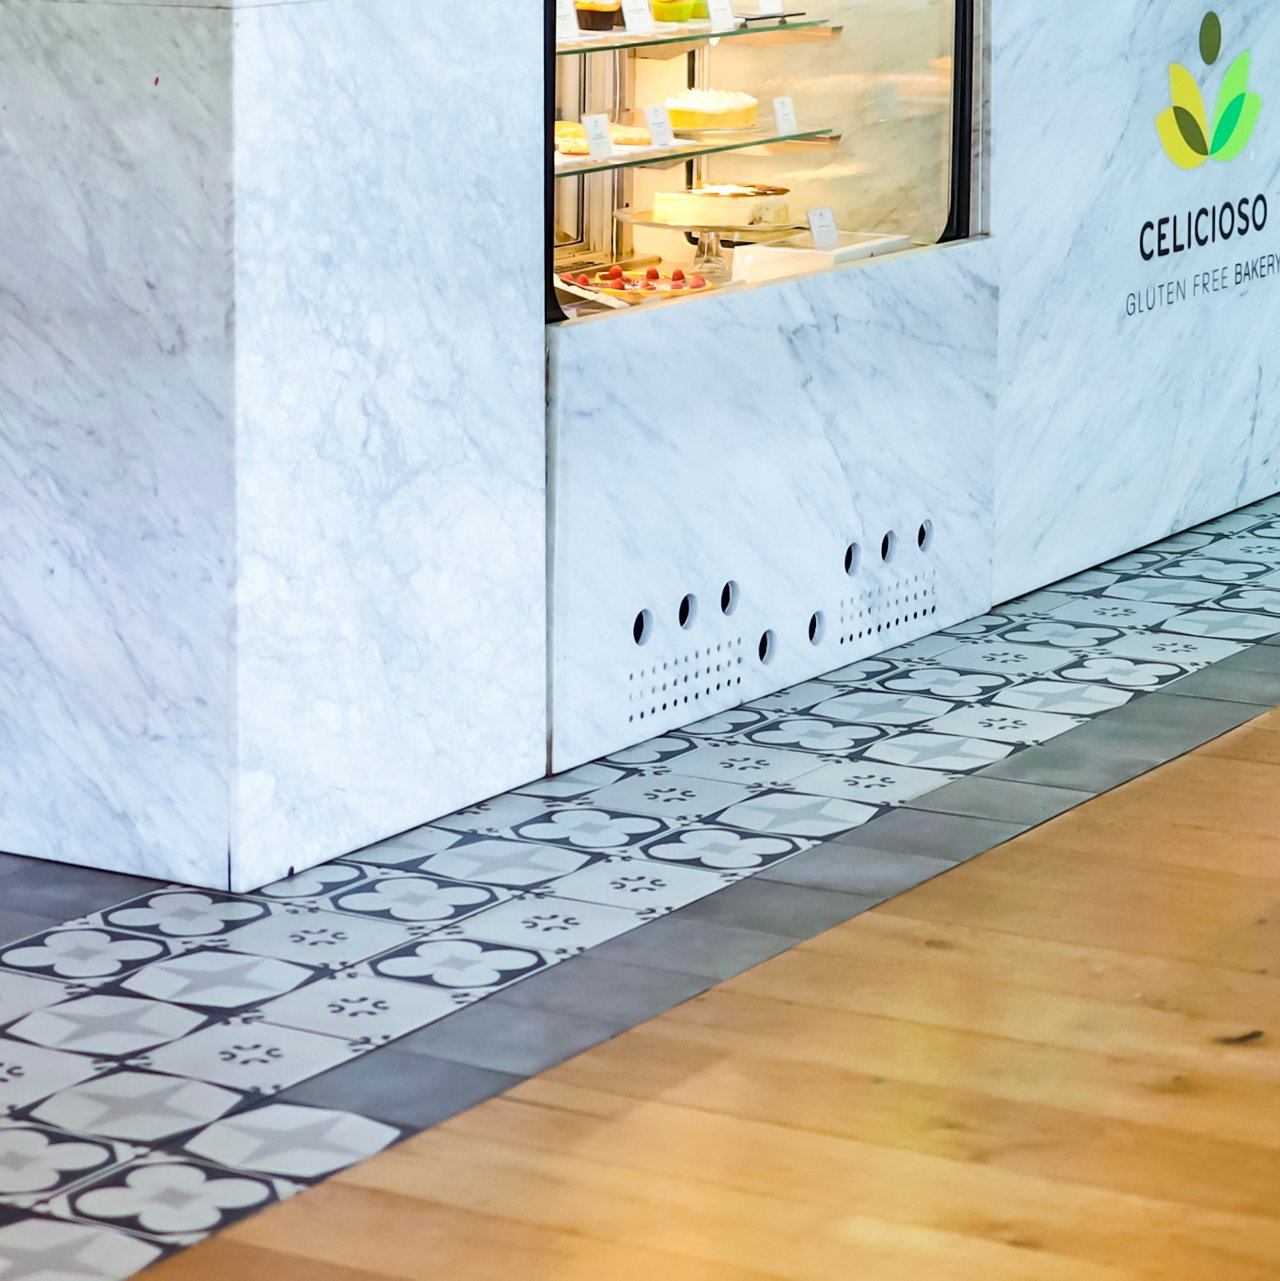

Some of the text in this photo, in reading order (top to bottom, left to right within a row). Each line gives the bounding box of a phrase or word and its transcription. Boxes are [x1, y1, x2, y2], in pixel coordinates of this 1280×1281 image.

[1139, 193, 1267, 261] CELICIOSO
[1126, 278, 1186, 316] GLUTEN
[1193, 266, 1229, 297] FREE
